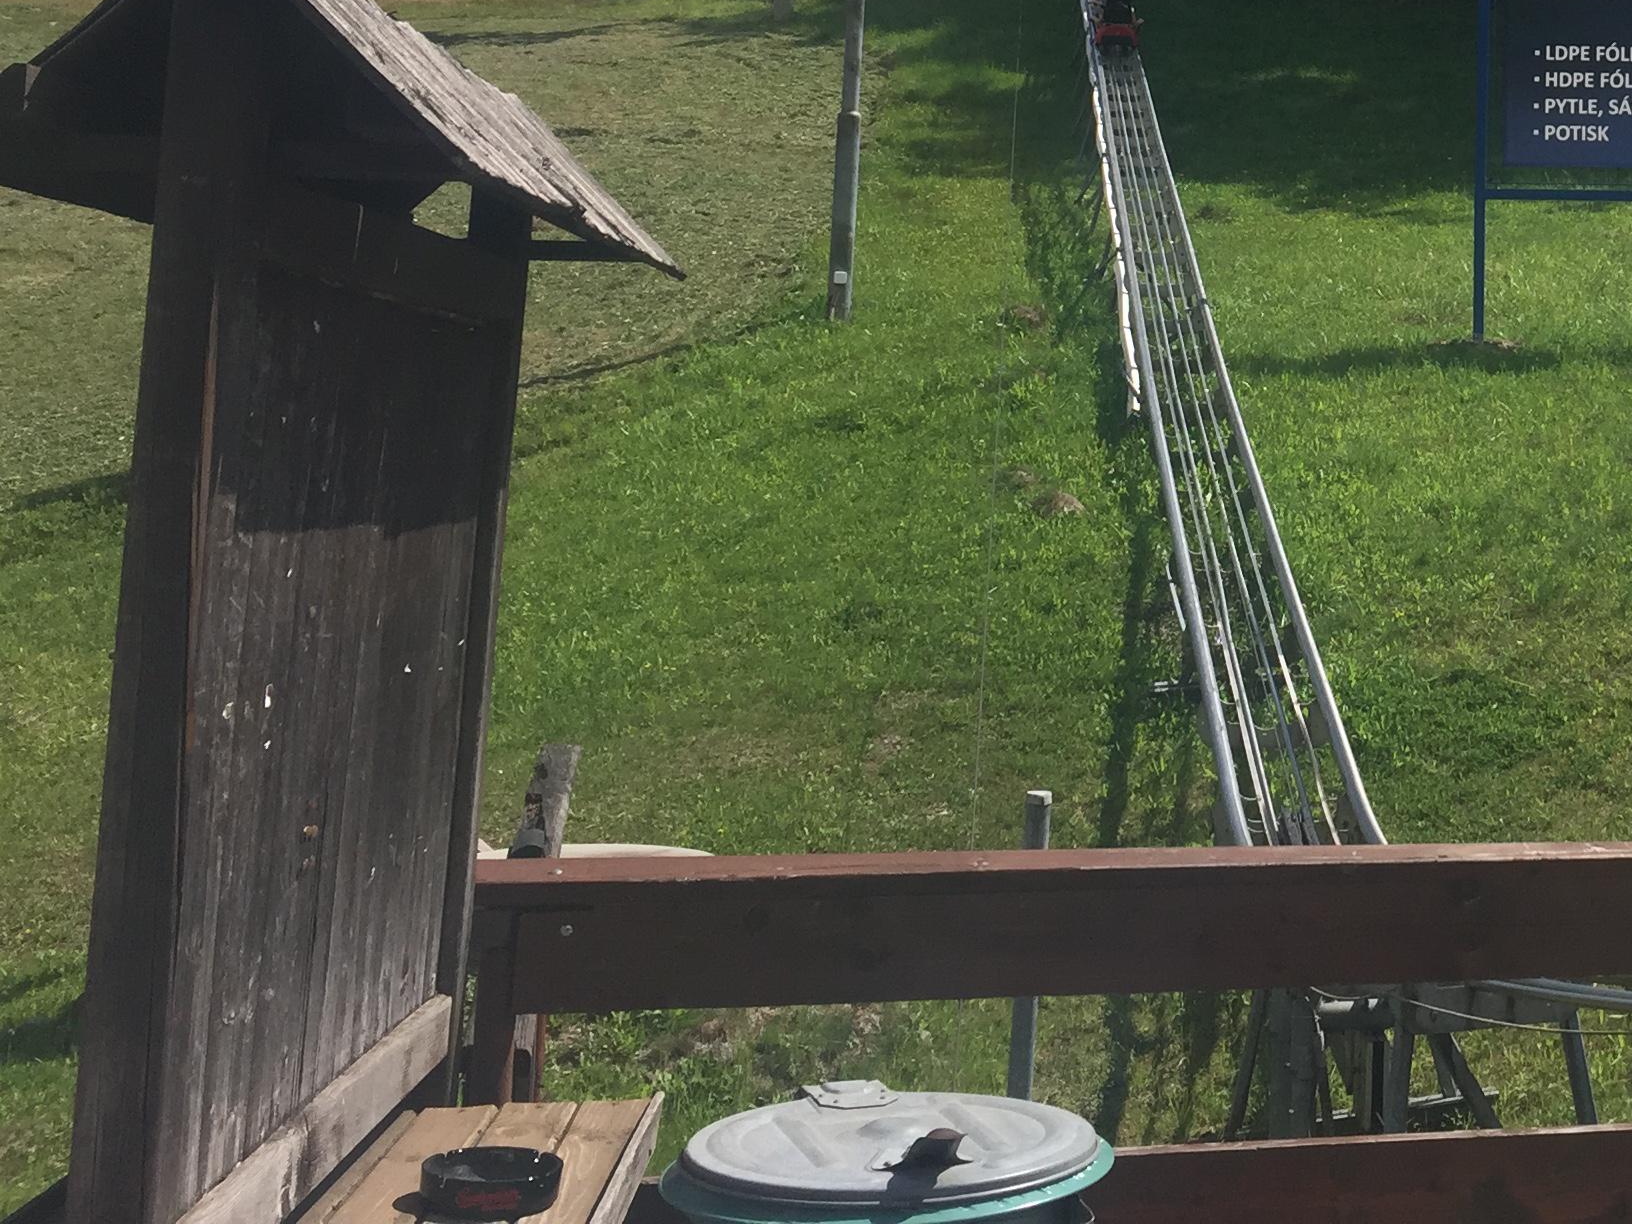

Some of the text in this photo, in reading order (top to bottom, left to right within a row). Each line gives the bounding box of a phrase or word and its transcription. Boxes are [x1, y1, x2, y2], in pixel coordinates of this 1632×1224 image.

[1545, 45, 1590, 61] LDPE
[1545, 72, 1595, 88] HDPE
[1544, 98, 1603, 118] PYTLE,
[1544, 124, 1609, 141] POTISK
